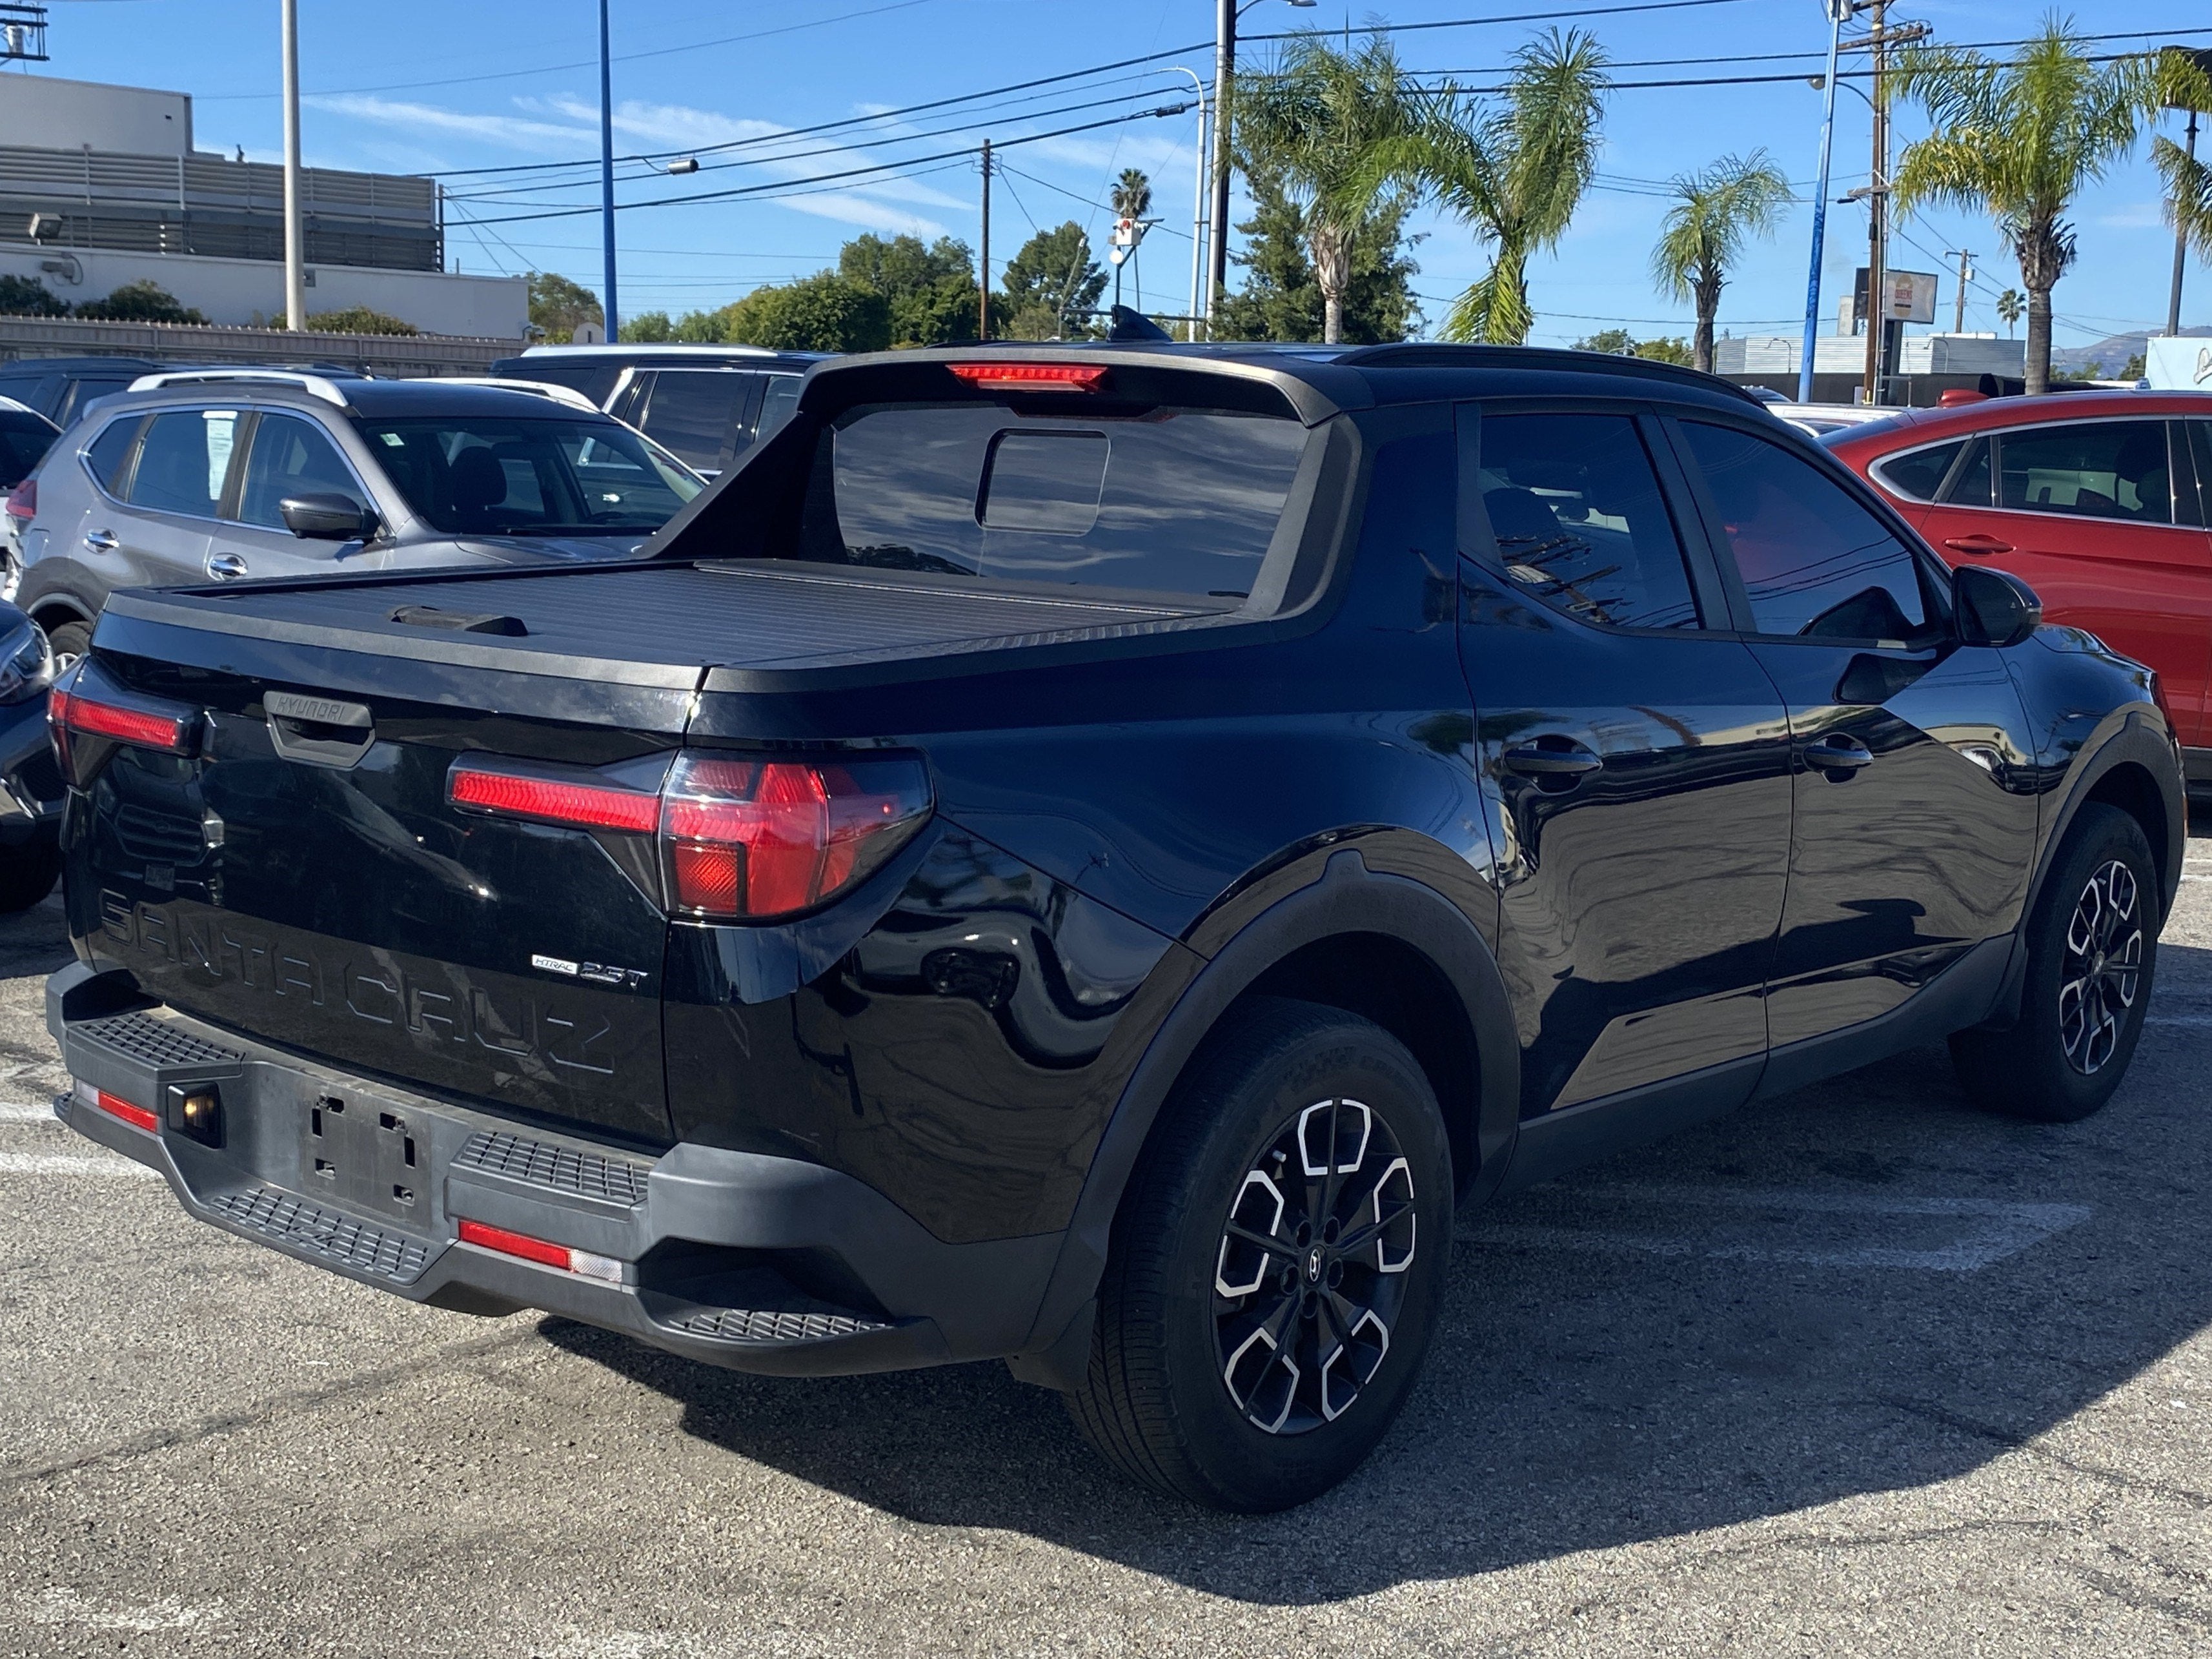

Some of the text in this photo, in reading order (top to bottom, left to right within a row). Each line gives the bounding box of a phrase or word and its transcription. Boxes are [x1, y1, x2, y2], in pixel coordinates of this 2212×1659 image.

[276, 695, 345, 722] HYUNDAI
[534, 957, 574, 973] HTRAC
[98, 887, 616, 1075] SANTA CRUZ
